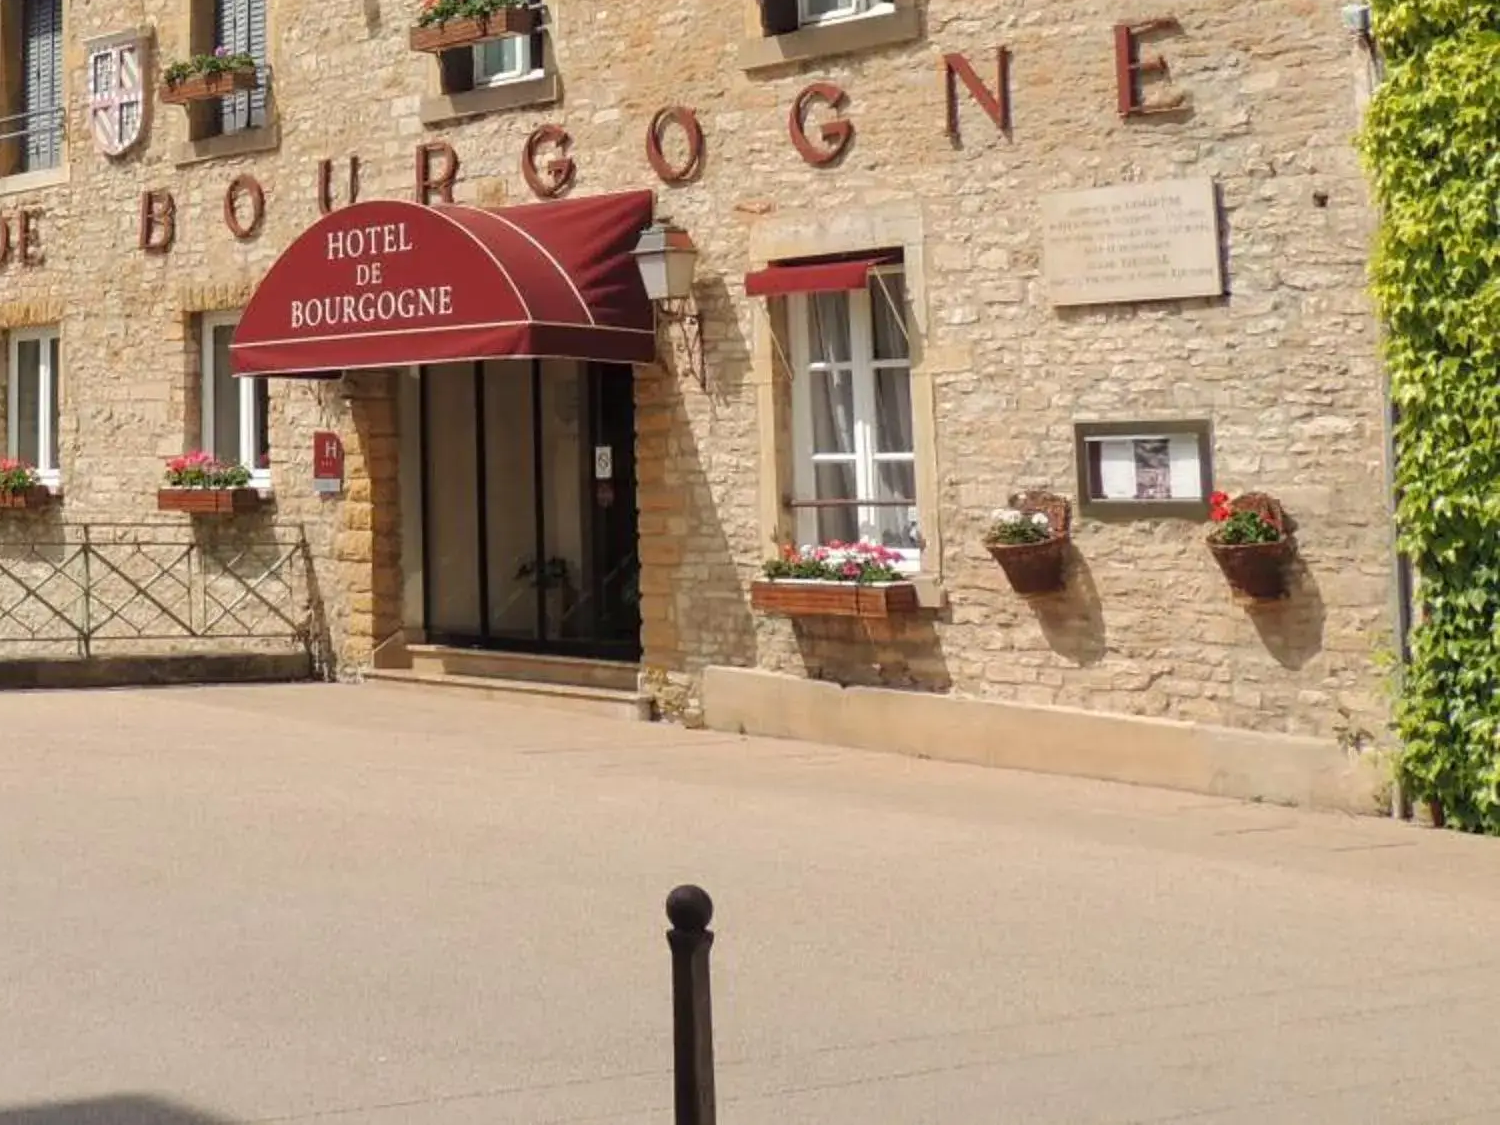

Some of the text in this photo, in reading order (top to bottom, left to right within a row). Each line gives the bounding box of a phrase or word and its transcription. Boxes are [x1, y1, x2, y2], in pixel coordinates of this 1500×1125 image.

[138, 16, 1190, 253] BOURGOGNE
[326, 222, 413, 260] HOTEL
[355, 262, 383, 286] DE
[291, 285, 453, 329] BOURGOGNE
[325, 439, 337, 460] H
